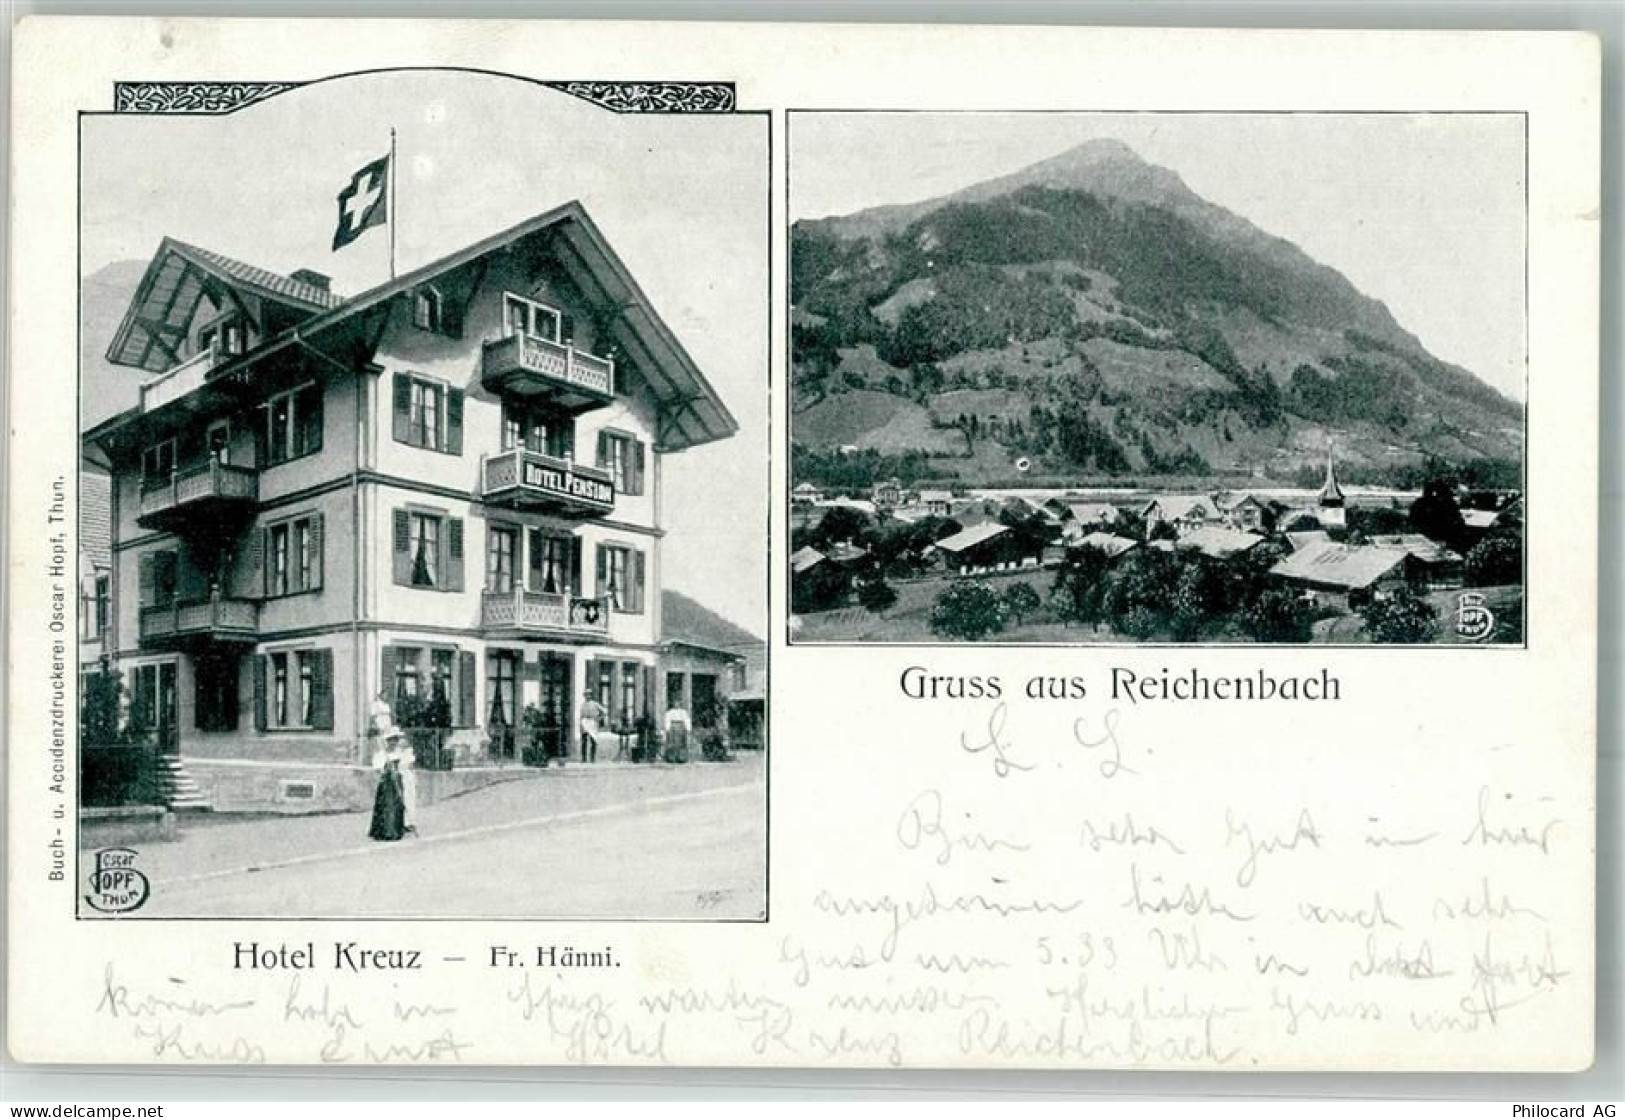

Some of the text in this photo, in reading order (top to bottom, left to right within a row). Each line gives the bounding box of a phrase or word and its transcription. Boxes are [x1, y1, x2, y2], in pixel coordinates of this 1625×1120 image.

[48, 475, 65, 523] Thun.
[49, 585, 65, 632] Oscar
[899, 666, 1341, 703] Gruss aus Reichenbach
[53, 803, 65, 818] u.
[233, 941, 314, 969] Hotel
[335, 941, 421, 972] Kreuz
[489, 945, 524, 967] Fr.
[536, 945, 621, 967] Hänni.
